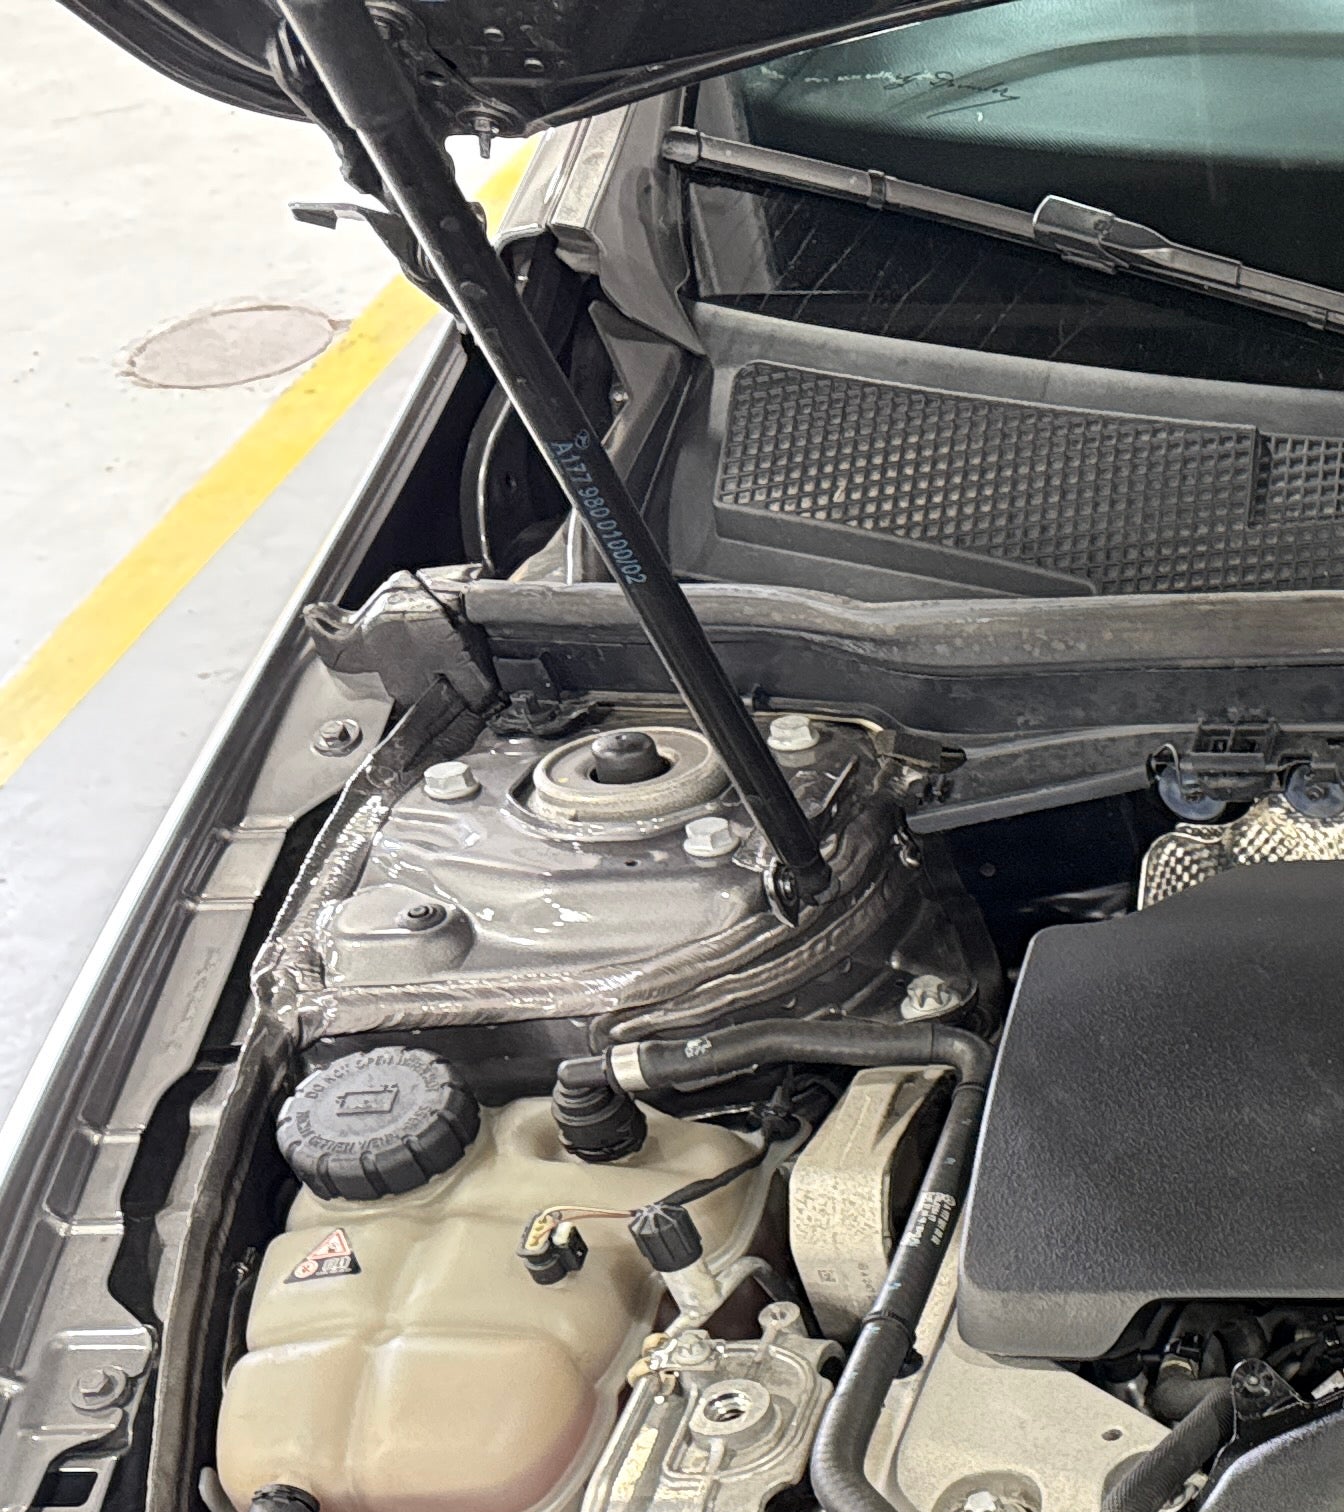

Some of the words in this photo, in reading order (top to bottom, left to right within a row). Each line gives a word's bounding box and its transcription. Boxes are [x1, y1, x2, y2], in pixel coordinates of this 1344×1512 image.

[550, 442, 592, 482] A177
[577, 486, 610, 518] 980
[596, 519, 647, 585] 0100/02
